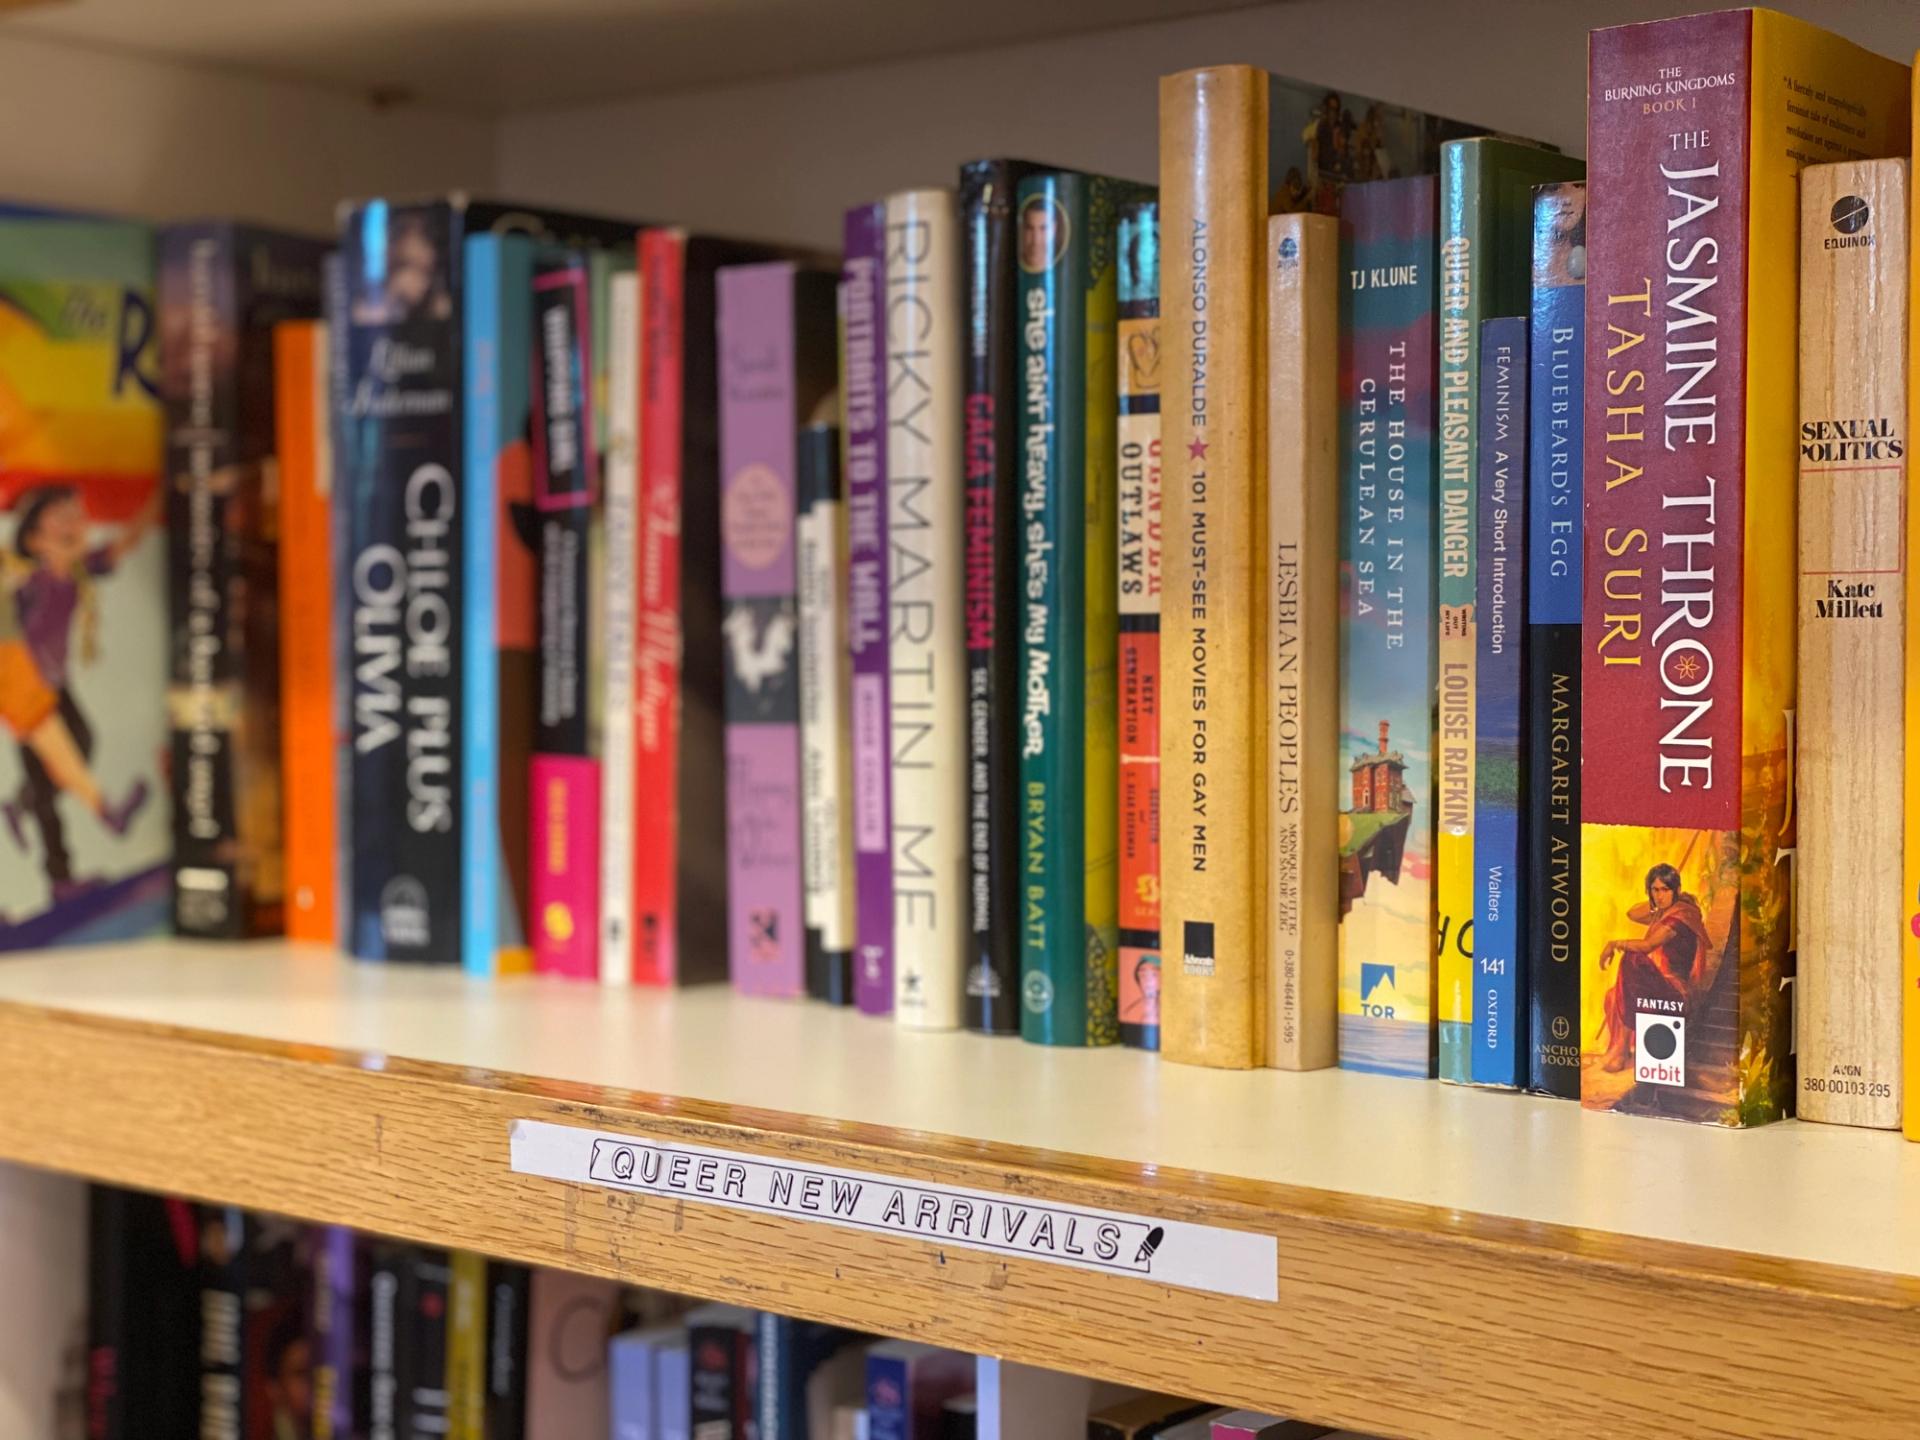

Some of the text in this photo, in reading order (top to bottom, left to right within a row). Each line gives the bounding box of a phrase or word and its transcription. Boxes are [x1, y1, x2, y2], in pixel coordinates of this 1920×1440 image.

[1604, 72, 1736, 102] BURNING KINGDOMS
[1642, 99, 1687, 116] BOOK
[1658, 66, 1682, 80] THE
[1668, 129, 1711, 152] THE
[1025, 287, 1055, 351] she
[1192, 218, 1208, 427] ALONSO DURALDE
[1350, 265, 1418, 290] TJ KLUNE
[965, 393, 996, 479] GAGA
[1442, 237, 1471, 578] QUEER AND PLEASANT DANGER
[1550, 327, 1574, 578] BLUEBEARD'S EGG
[1801, 418, 1895, 441] SEXUAL
[1121, 442, 1143, 595] OUTLAWS
[1358, 378, 1376, 616] CERULEAN SEA
[1387, 341, 1406, 650] THE HOUSE IN THE
[1491, 346, 1511, 655] FEMINISM A Very Short Introduction
[1596, 276, 1652, 668] TASHA SURI
[1650, 159, 1720, 795] JASMINE THRONE
[404, 461, 457, 679] CHLOE
[887, 220, 936, 931] RICKY MARTIN ME
[965, 486, 996, 650] FEMINISM
[1815, 599, 1884, 619] Millett
[1826, 579, 1876, 599] Kate
[1125, 647, 1138, 744] GENERATION
[1142, 674, 1154, 715] NEXT
[1192, 472, 1207, 872] 101 MUST-SEE MOVIES FOR GAY MEN
[1277, 541, 1298, 814] LESBIAN PEOPLES
[404, 697, 453, 833] PLUS
[1443, 662, 1469, 828] LOUISE RAFKIN
[1026, 781, 1045, 951] BRYAN BATT
[1550, 672, 1570, 963] MARGARET ATWOOD
[1279, 826, 1289, 932] AND SANDE ZEIG
[1287, 822, 1297, 936] MONIQUE WITTIG
[1487, 866, 1503, 922] Walters
[1361, 1003, 1395, 1020] TOR
[1480, 957, 1505, 976] 141
[1487, 989, 1499, 1049] OXFORD
[1636, 997, 1684, 1014] FANTASY
[1535, 1043, 1581, 1057] ANCHO
[1540, 1054, 1580, 1067] BOOKS
[1639, 1063, 1682, 1084] orbit
[610, 1146, 1122, 1261] QUEER NEW ARRIVALS
